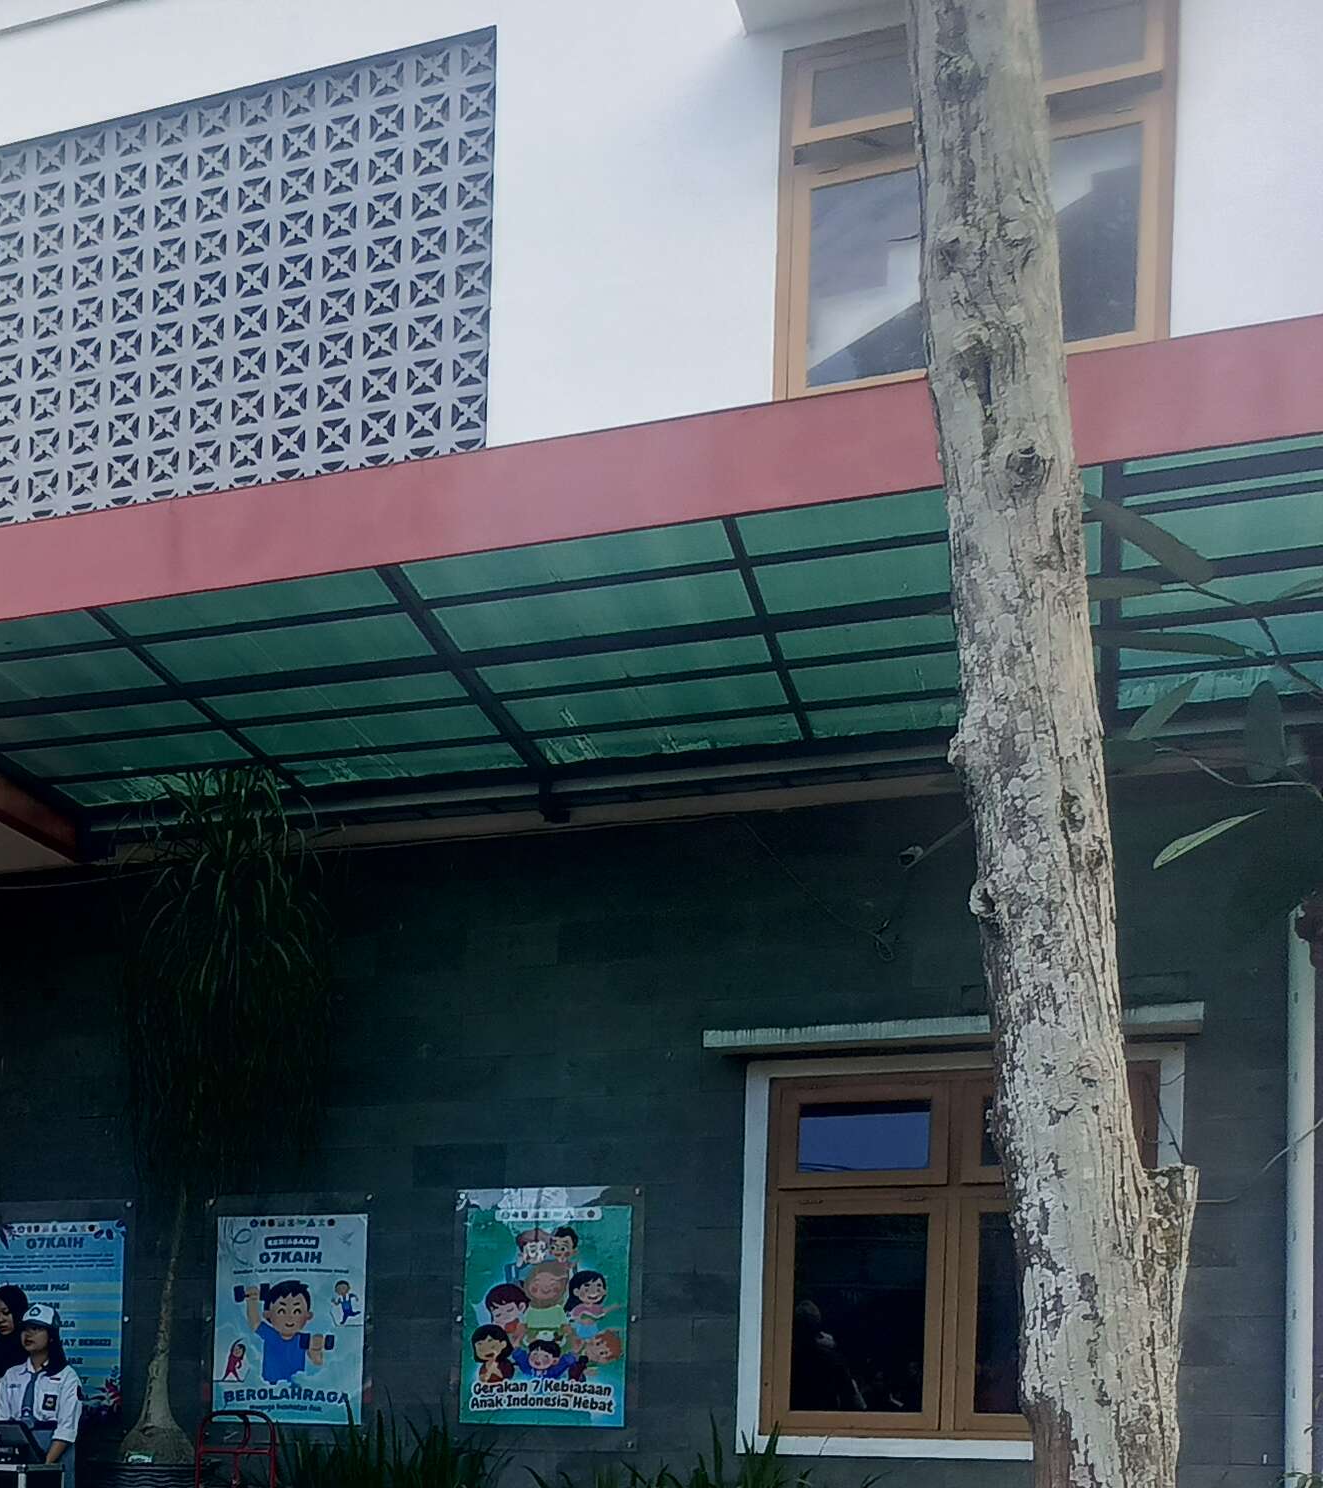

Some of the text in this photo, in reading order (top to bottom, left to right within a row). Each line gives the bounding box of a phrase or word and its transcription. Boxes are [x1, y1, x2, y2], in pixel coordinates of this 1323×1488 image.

[223, 1387, 351, 1405] BEROLAHRAGA
[473, 1379, 612, 1396] Gerakan 7 Kebiasaan
[470, 1394, 614, 1413] Anak Indonesia Hebat
